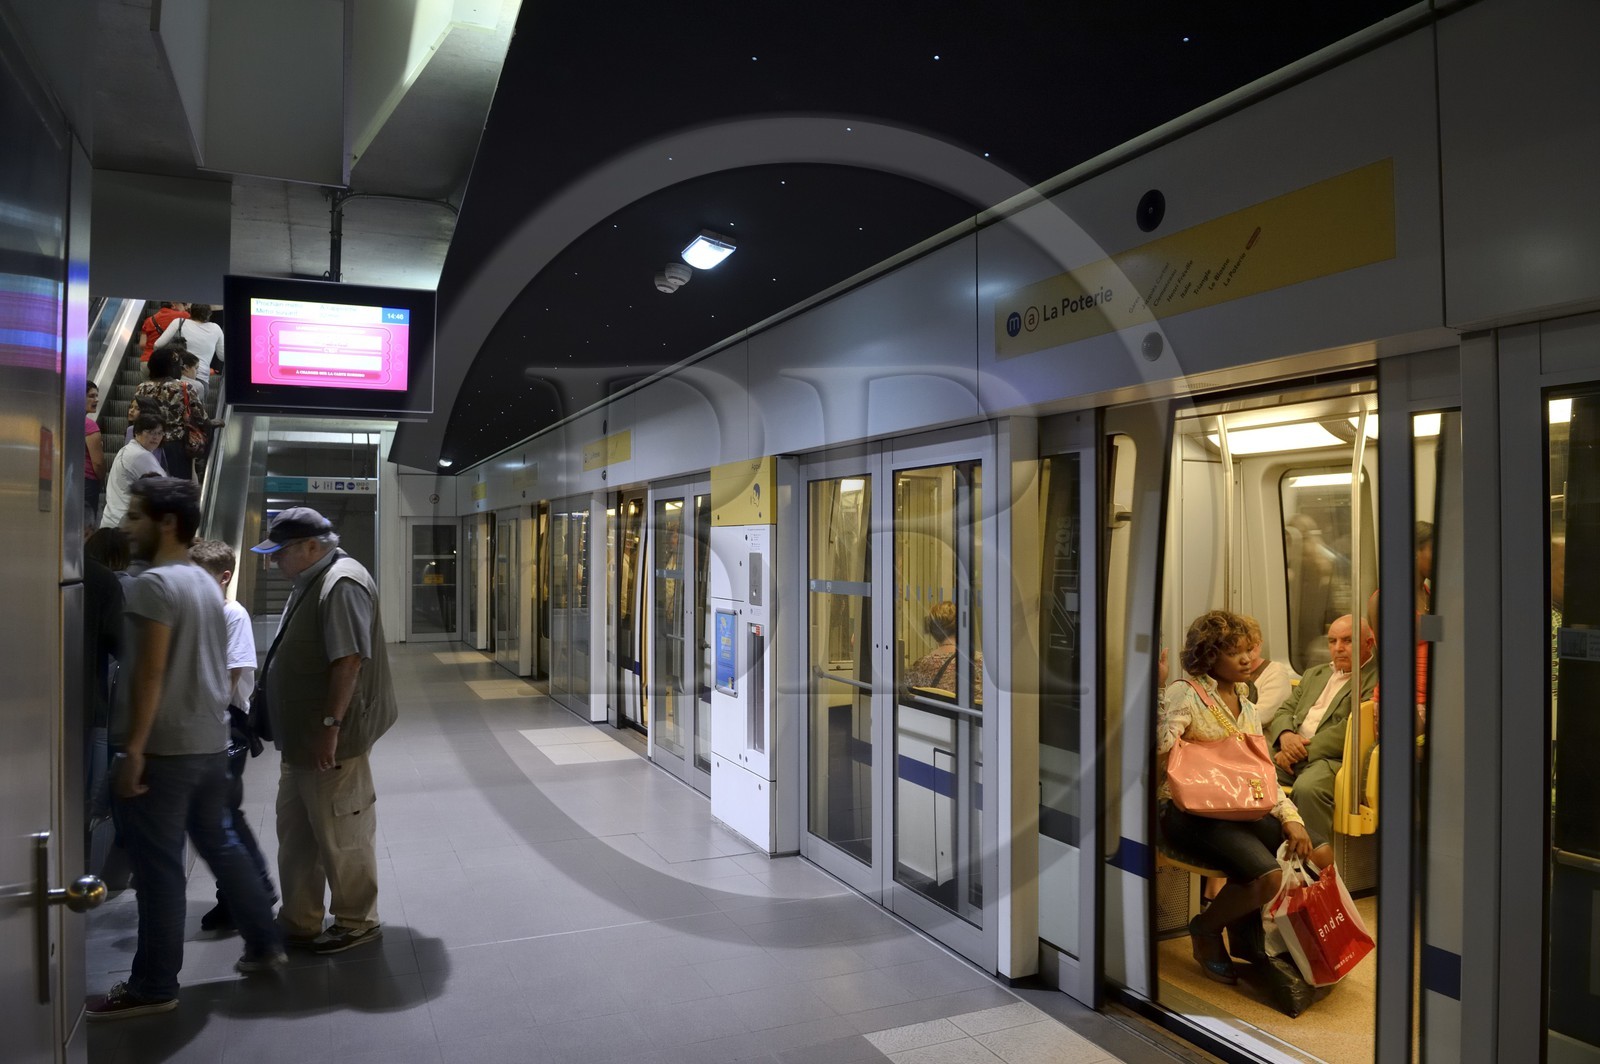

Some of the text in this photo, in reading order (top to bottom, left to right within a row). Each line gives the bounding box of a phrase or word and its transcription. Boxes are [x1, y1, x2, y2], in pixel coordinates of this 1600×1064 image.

[1229, 252, 1247, 278] Poterie
[1193, 269, 1211, 295] Triangle
[1043, 305, 1058, 322] La
[1061, 286, 1113, 316] Poterie
